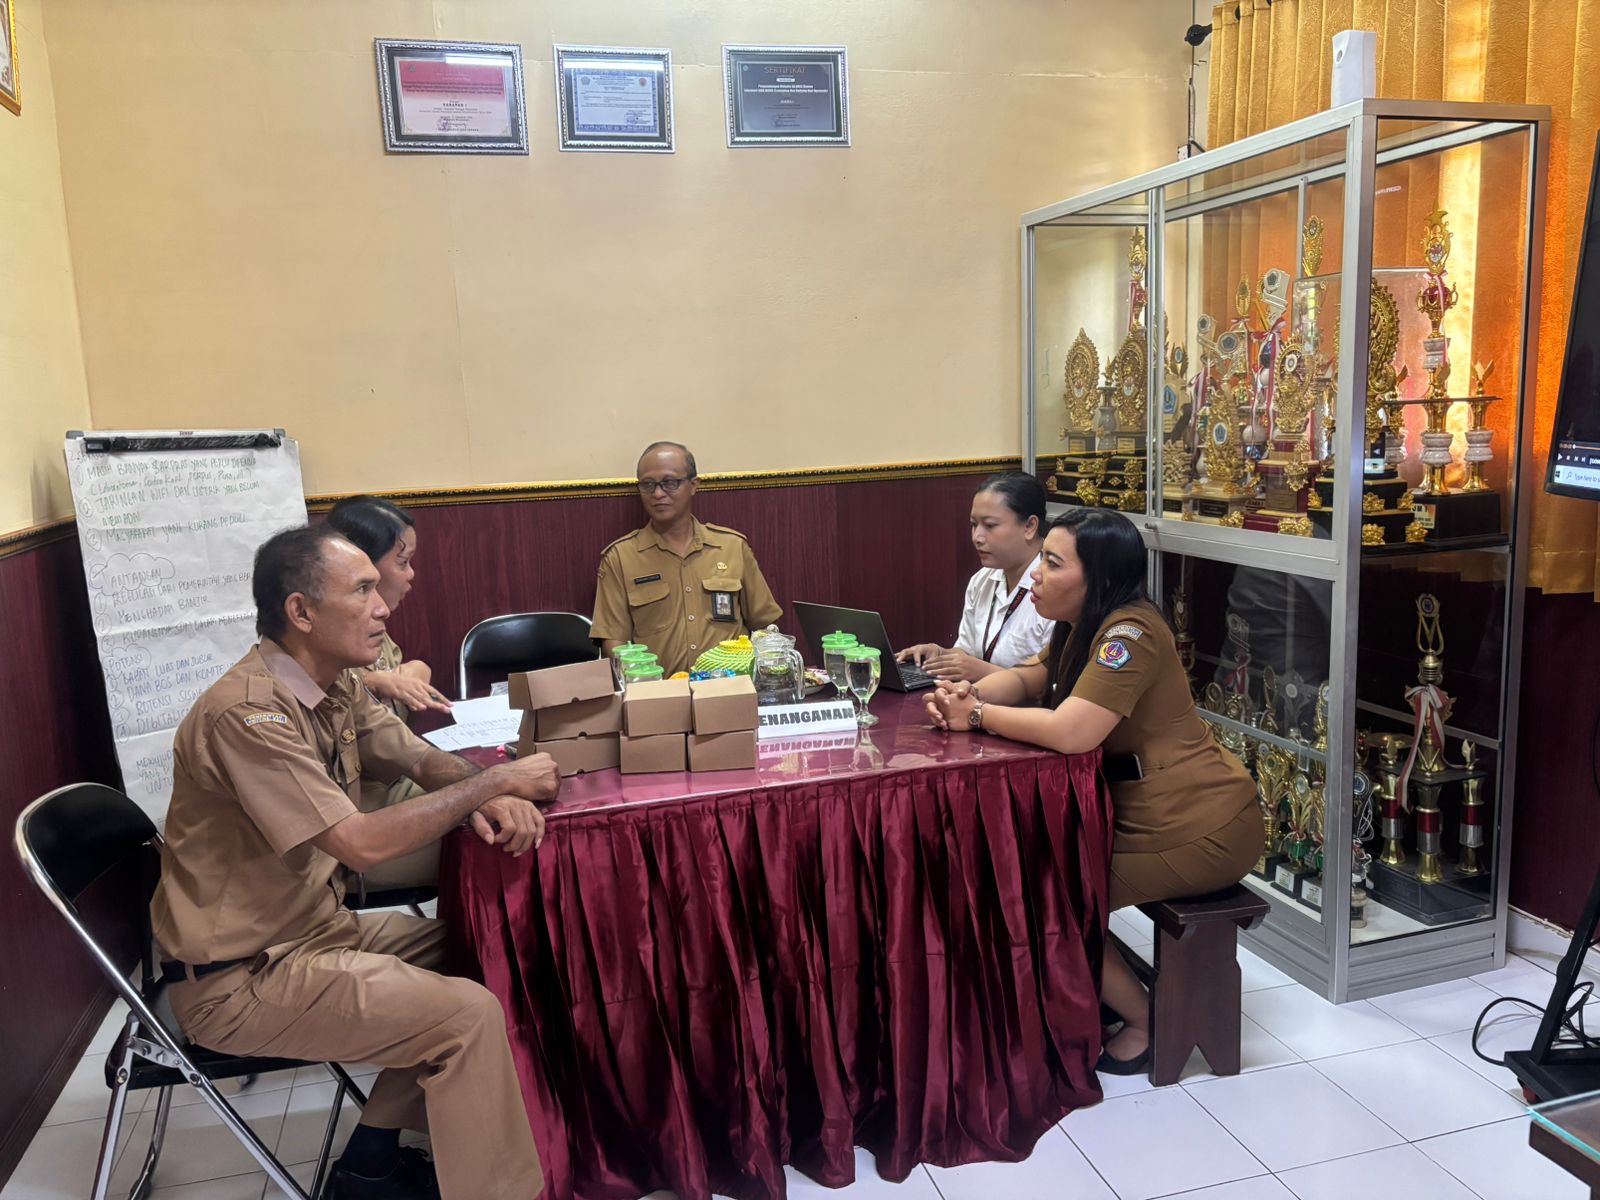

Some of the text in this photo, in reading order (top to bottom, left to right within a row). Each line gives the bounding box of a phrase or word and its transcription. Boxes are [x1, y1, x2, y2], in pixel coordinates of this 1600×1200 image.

[155, 662, 174, 677] LUAS
[176, 657, 190, 670] DAN
[154, 677, 172, 692] BOS
[137, 708, 189, 735] DIGITALIS
[758, 707, 854, 726] ENANGANAN
[146, 776, 172, 794] UNTU
